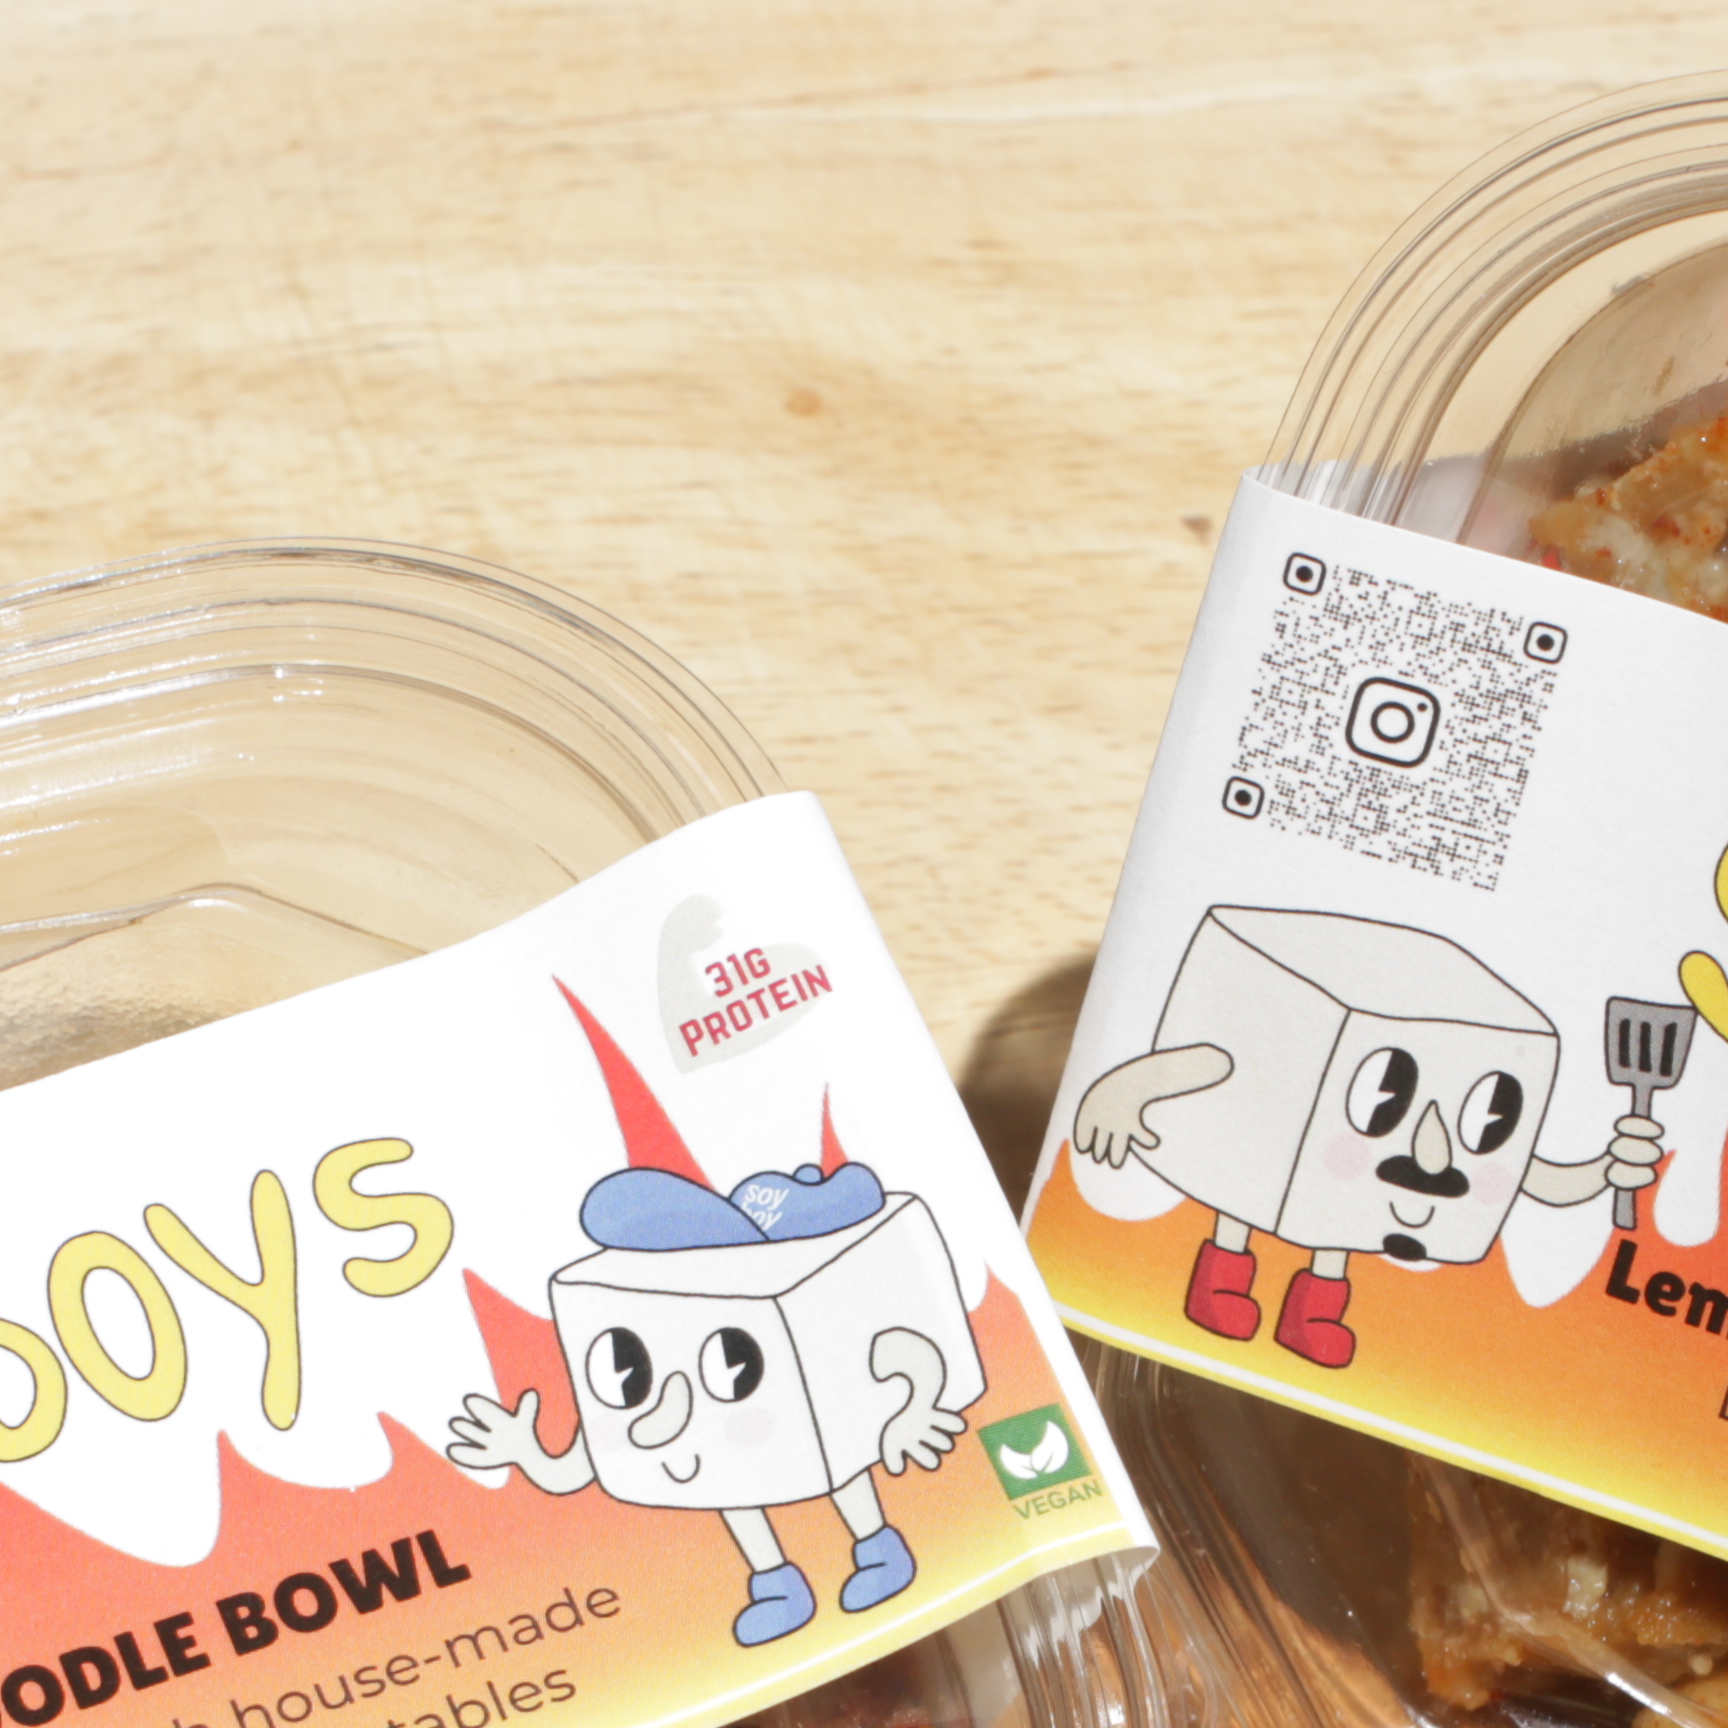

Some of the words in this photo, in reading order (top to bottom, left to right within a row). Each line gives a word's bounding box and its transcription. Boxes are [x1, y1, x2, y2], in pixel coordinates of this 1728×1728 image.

[704, 947, 771, 998] 31G
[678, 964, 833, 1058] PROTEIN
[744, 1184, 790, 1211] soy
[1013, 1479, 1104, 1520] VEGAN
[215, 1530, 471, 1656] BOWL
